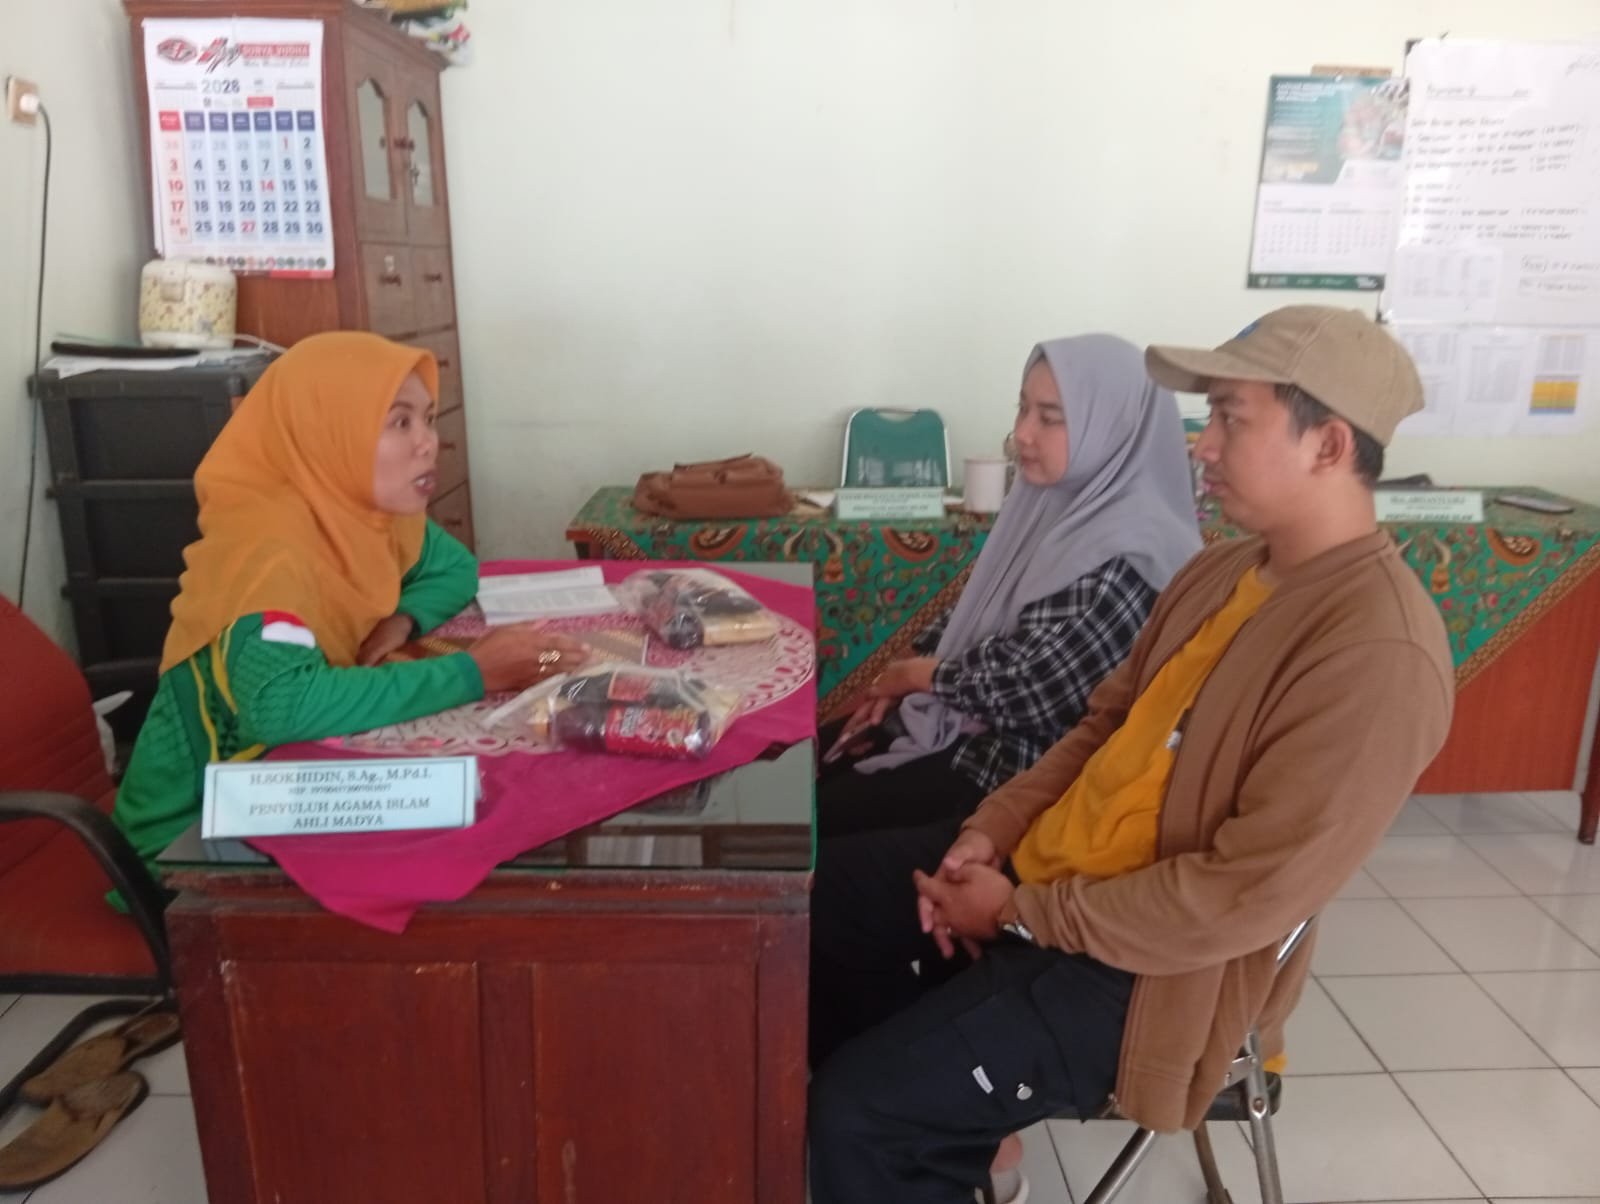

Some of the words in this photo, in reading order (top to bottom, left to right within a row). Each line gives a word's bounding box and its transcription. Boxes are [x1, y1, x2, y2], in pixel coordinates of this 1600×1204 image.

[283, 137, 289, 149] 1
[304, 137, 311, 149] 2
[170, 159, 178, 171] 3
[194, 159, 203, 171] 4
[218, 159, 226, 171] 5
[263, 159, 270, 171] 7
[284, 158, 291, 171] 8
[305, 158, 312, 171] 9
[168, 180, 183, 192] 10
[195, 180, 205, 192] 11
[217, 180, 230, 192] 12
[240, 180, 252, 192] 13
[261, 180, 274, 192] 14
[283, 180, 296, 192] 15
[305, 180, 318, 192] 16
[171, 201, 184, 213] 17
[195, 201, 209, 213] 18
[219, 201, 232, 213] 19
[240, 201, 255, 213] 20
[263, 201, 276, 213] 21
[284, 201, 298, 213] 22
[305, 201, 320, 213] 23
[195, 221, 212, 233] 25
[219, 221, 235, 233] 26
[241, 221, 256, 233] 27
[263, 221, 278, 233] 28
[284, 221, 300, 233] 29
[306, 221, 323, 233] 30
[250, 801, 329, 816] PENYULUH
[332, 799, 382, 814] AGAMA
[386, 797, 430, 810] ISLAM
[293, 815, 330, 829] AHLI
[332, 813, 384, 828] MADYA
